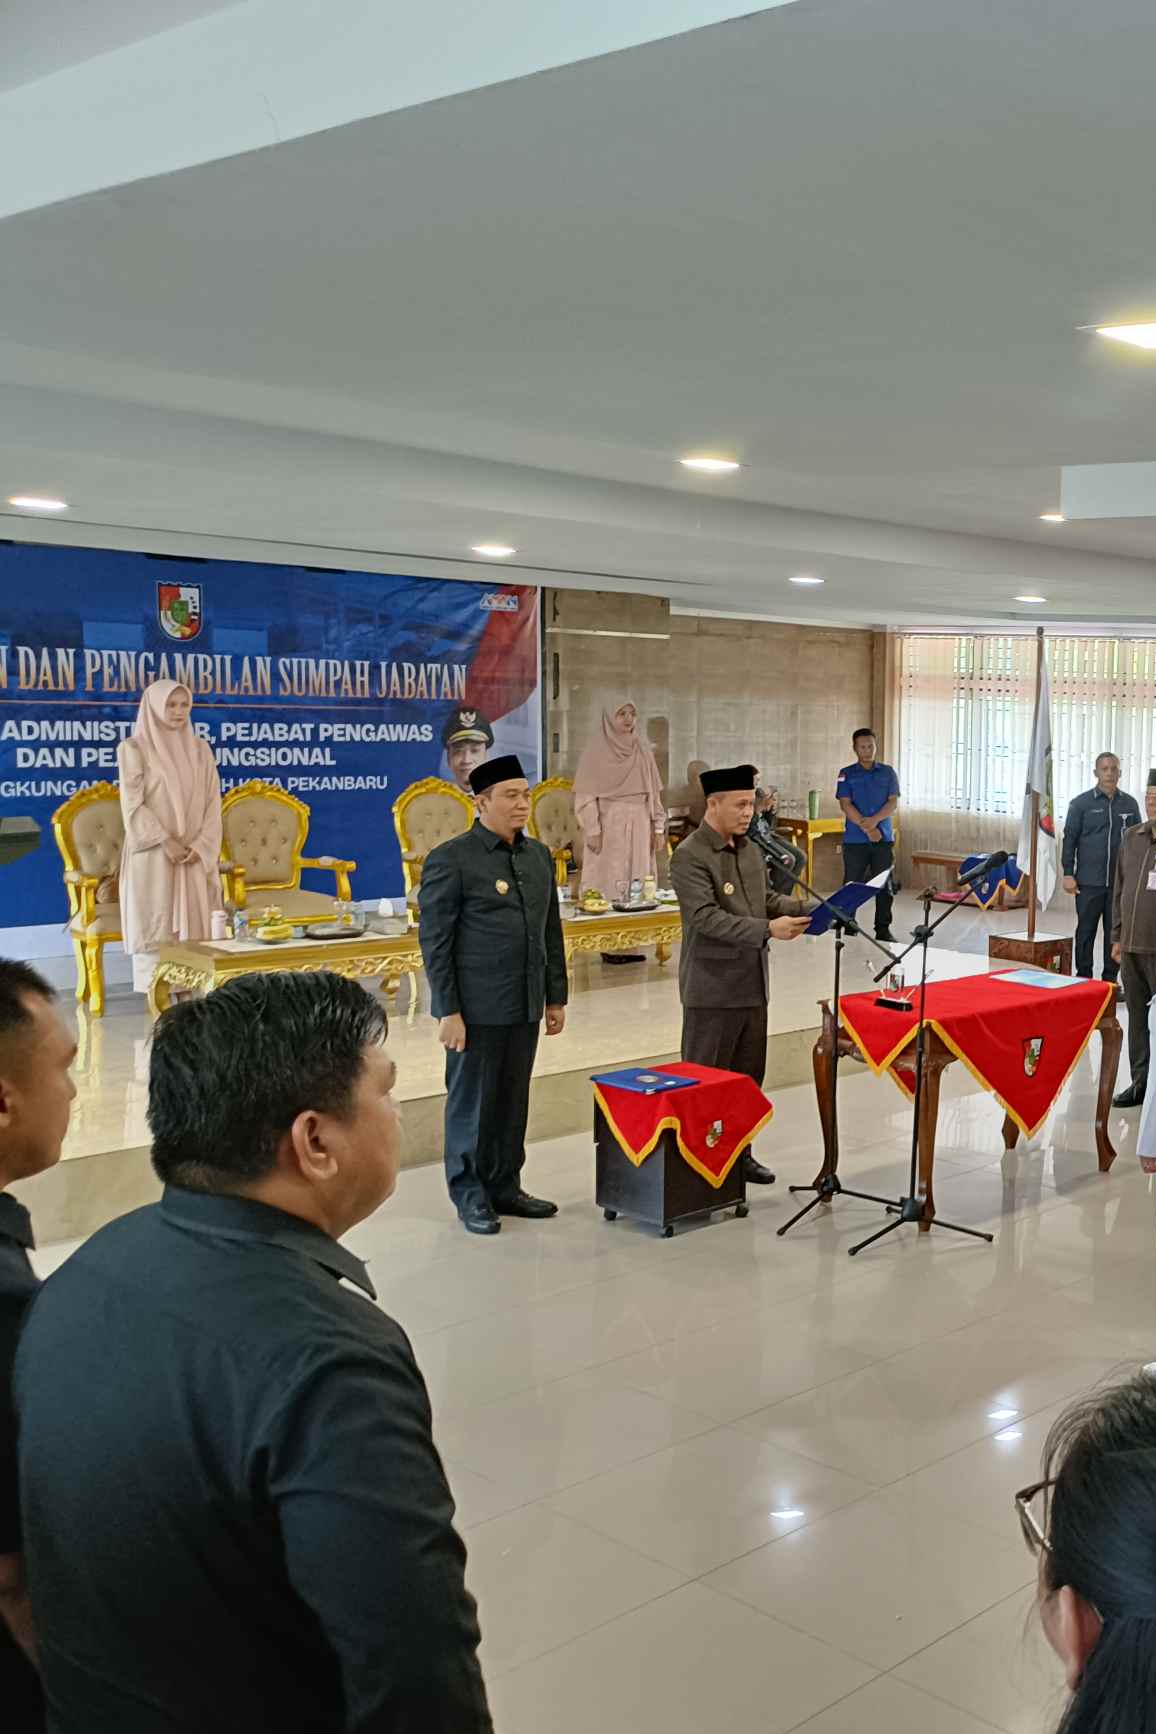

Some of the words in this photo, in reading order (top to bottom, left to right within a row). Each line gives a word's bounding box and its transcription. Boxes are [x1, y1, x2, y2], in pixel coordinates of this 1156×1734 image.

[16, 646, 76, 691] DAN
[84, 649, 272, 696] PENGAMBILAN
[278, 657, 371, 698] SUMPAH
[377, 661, 467, 700] JABATAN
[0, 720, 216, 744] ADMINISTR,
[221, 722, 315, 742] PEJABAT
[319, 723, 433, 742] PENGAWAS
[16, 747, 76, 768] DAN
[287, 775, 388, 792] PEKANBARU
